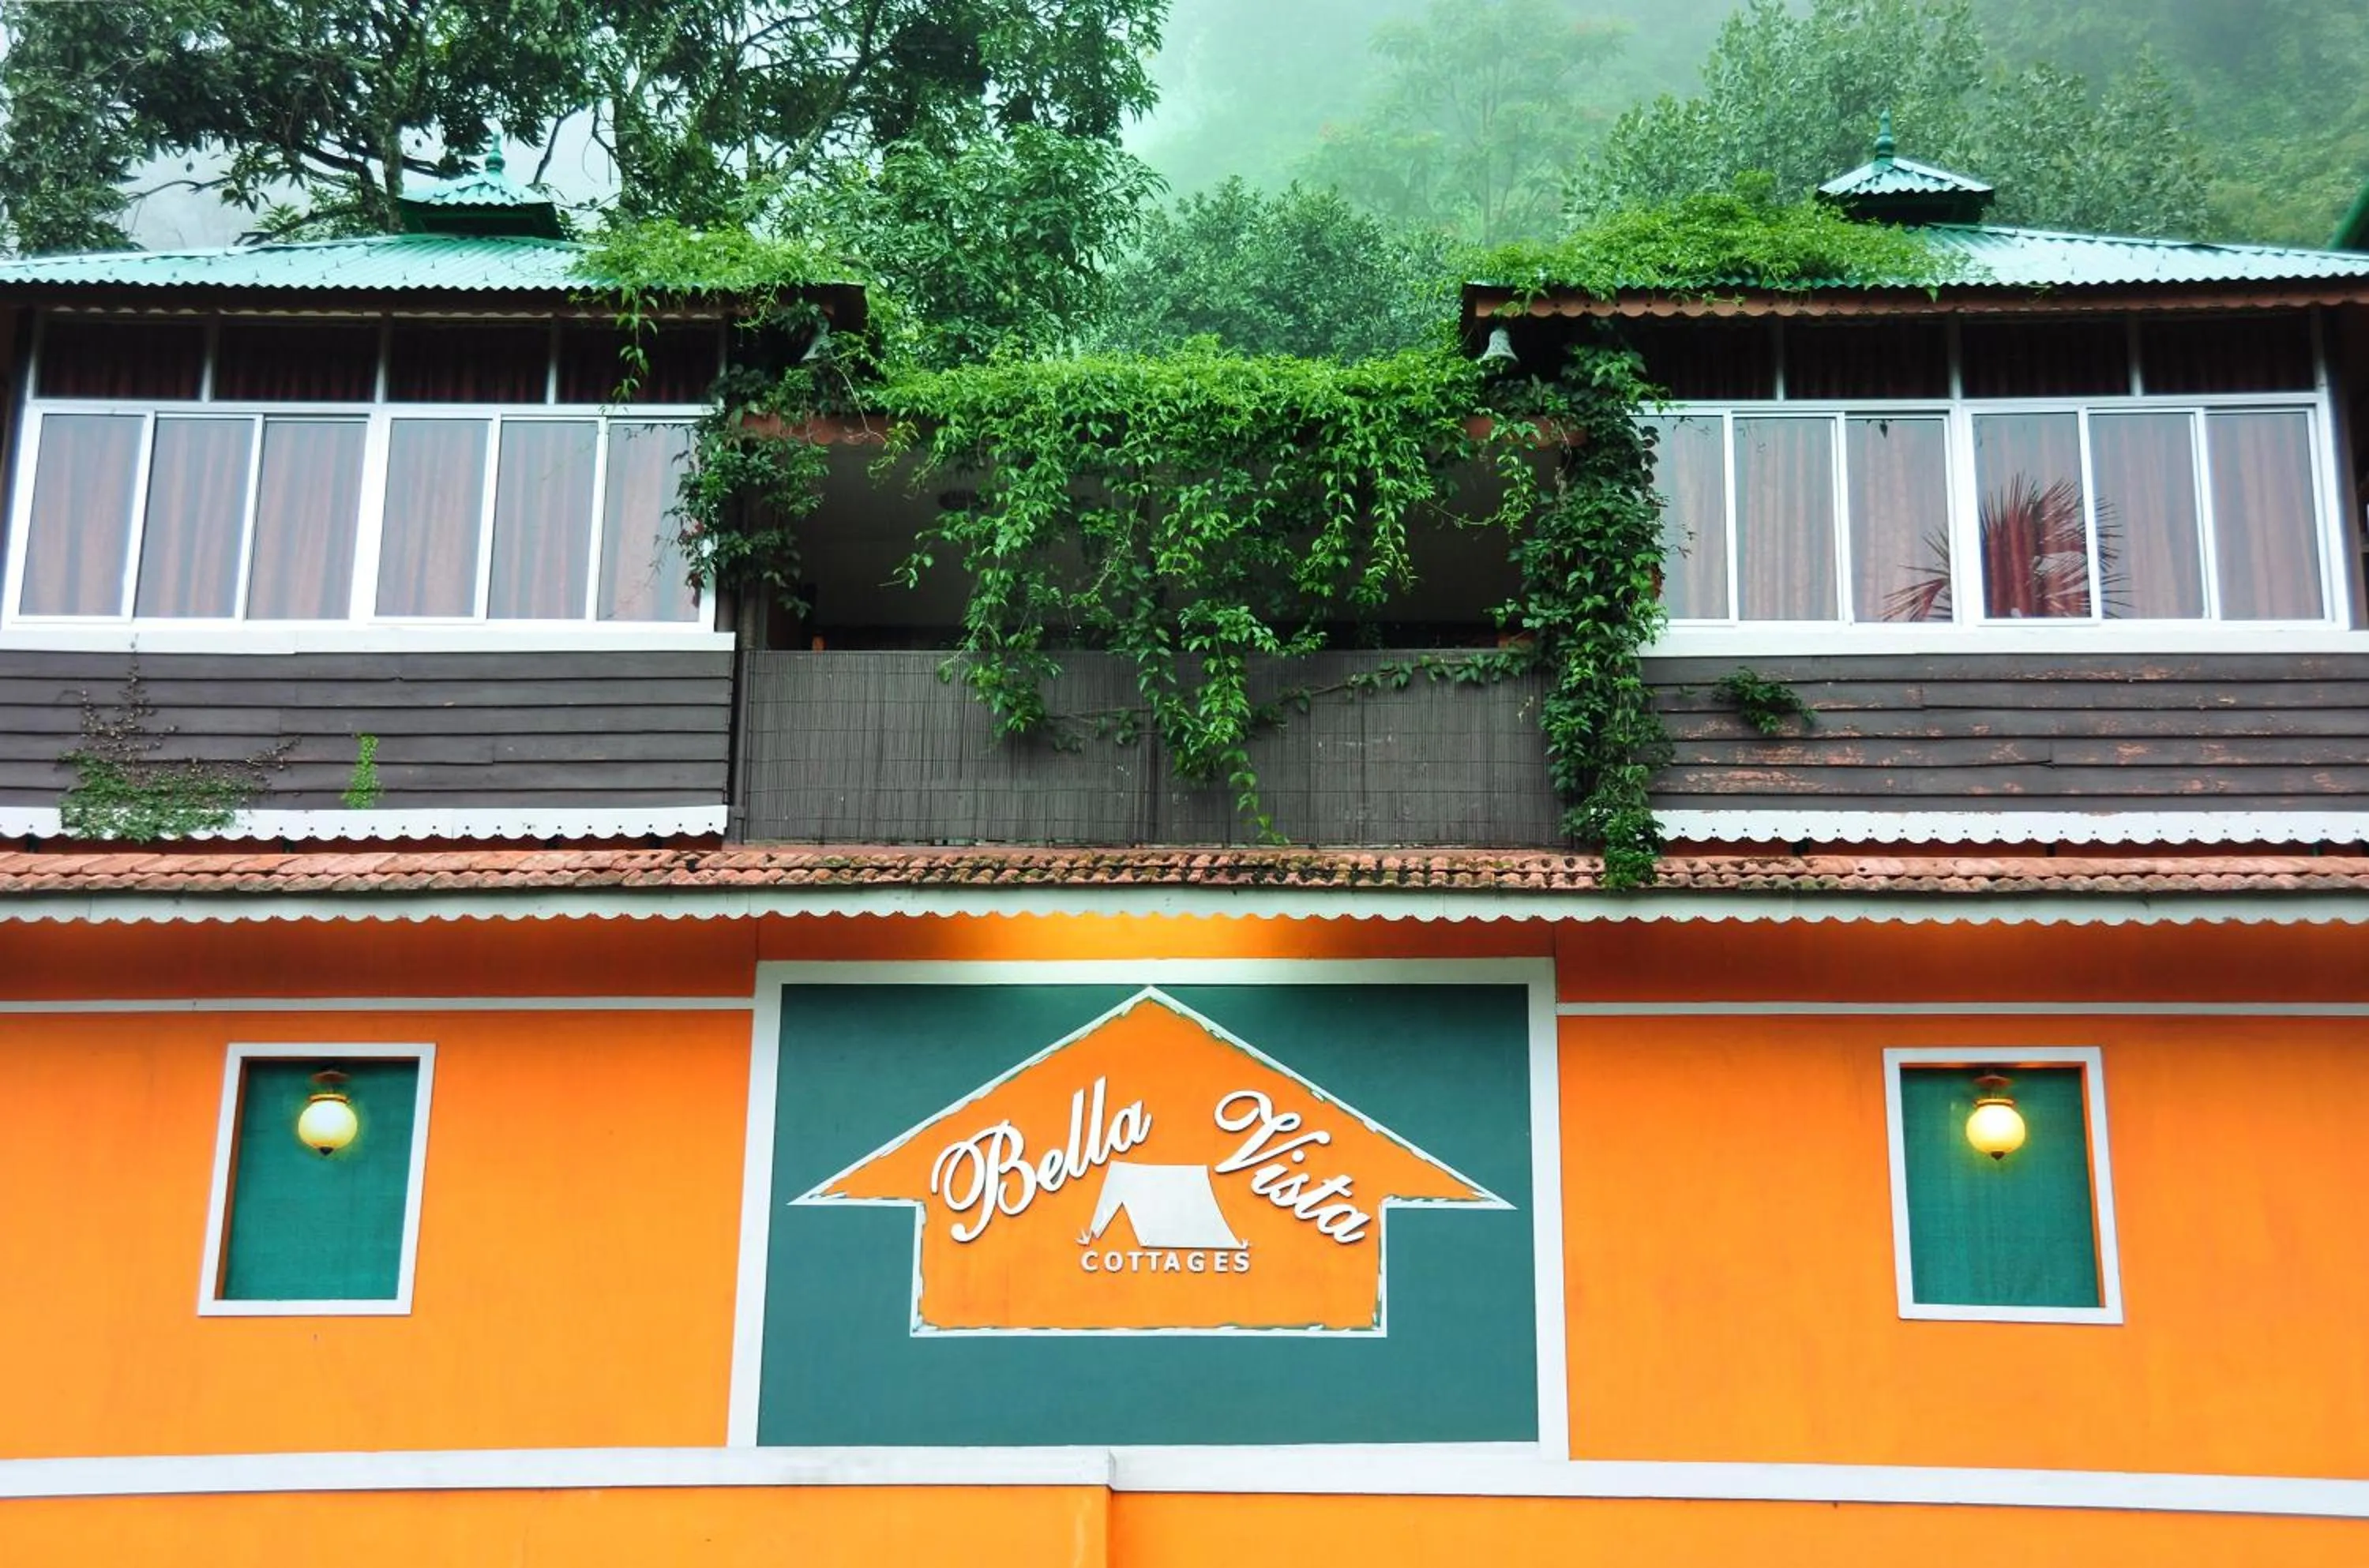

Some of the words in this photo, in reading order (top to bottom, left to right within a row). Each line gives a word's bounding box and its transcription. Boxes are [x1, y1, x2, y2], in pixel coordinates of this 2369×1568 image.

[931, 1075, 1152, 1244] Bella
[1214, 1090, 1372, 1244] Vista
[1080, 1251, 1251, 1273] COTTAGES
